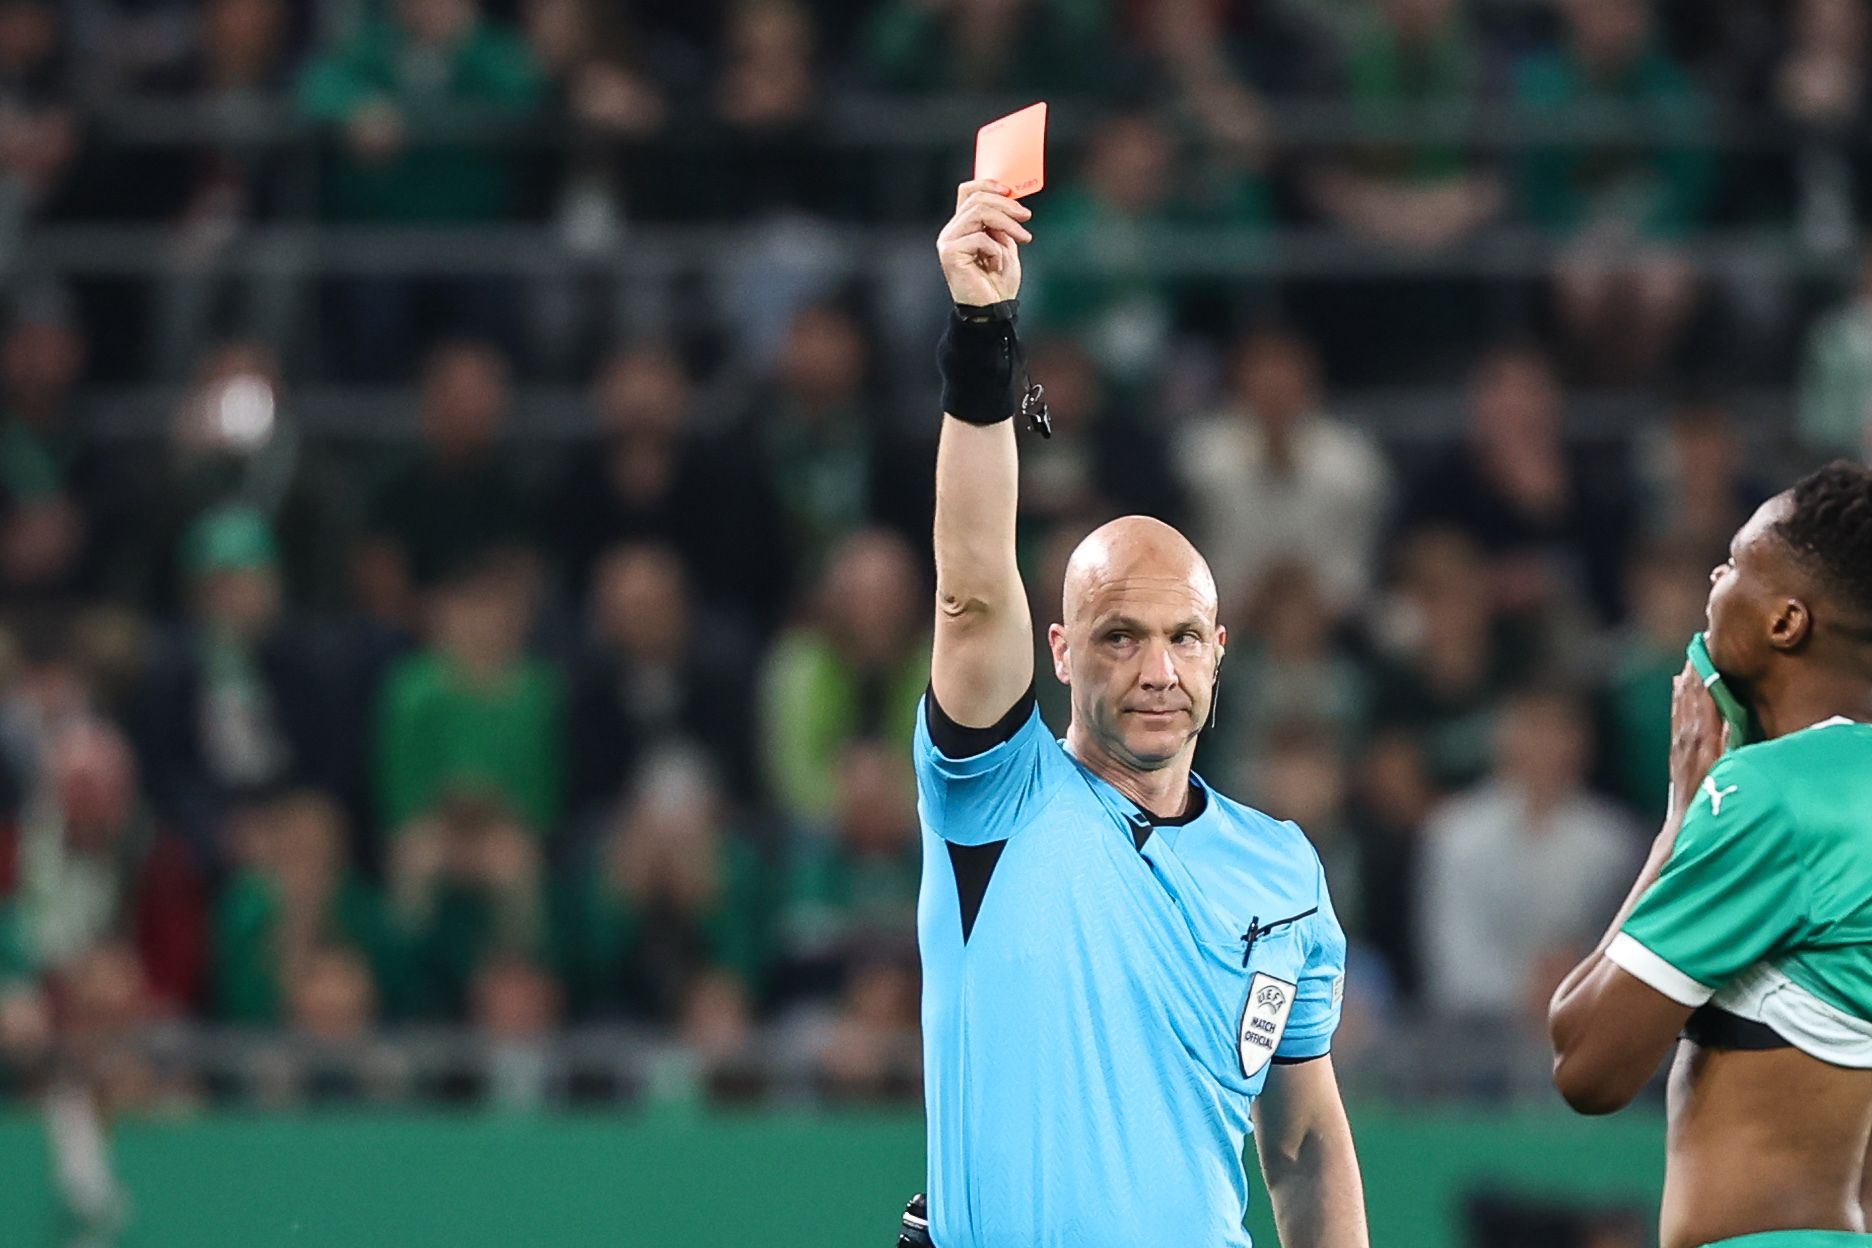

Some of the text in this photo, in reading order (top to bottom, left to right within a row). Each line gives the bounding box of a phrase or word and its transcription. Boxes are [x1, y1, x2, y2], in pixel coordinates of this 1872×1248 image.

[1256, 988, 1285, 1011] UEFA
[1250, 1016, 1276, 1034] MATCH
[1244, 1031, 1274, 1050] OFFICIAL
